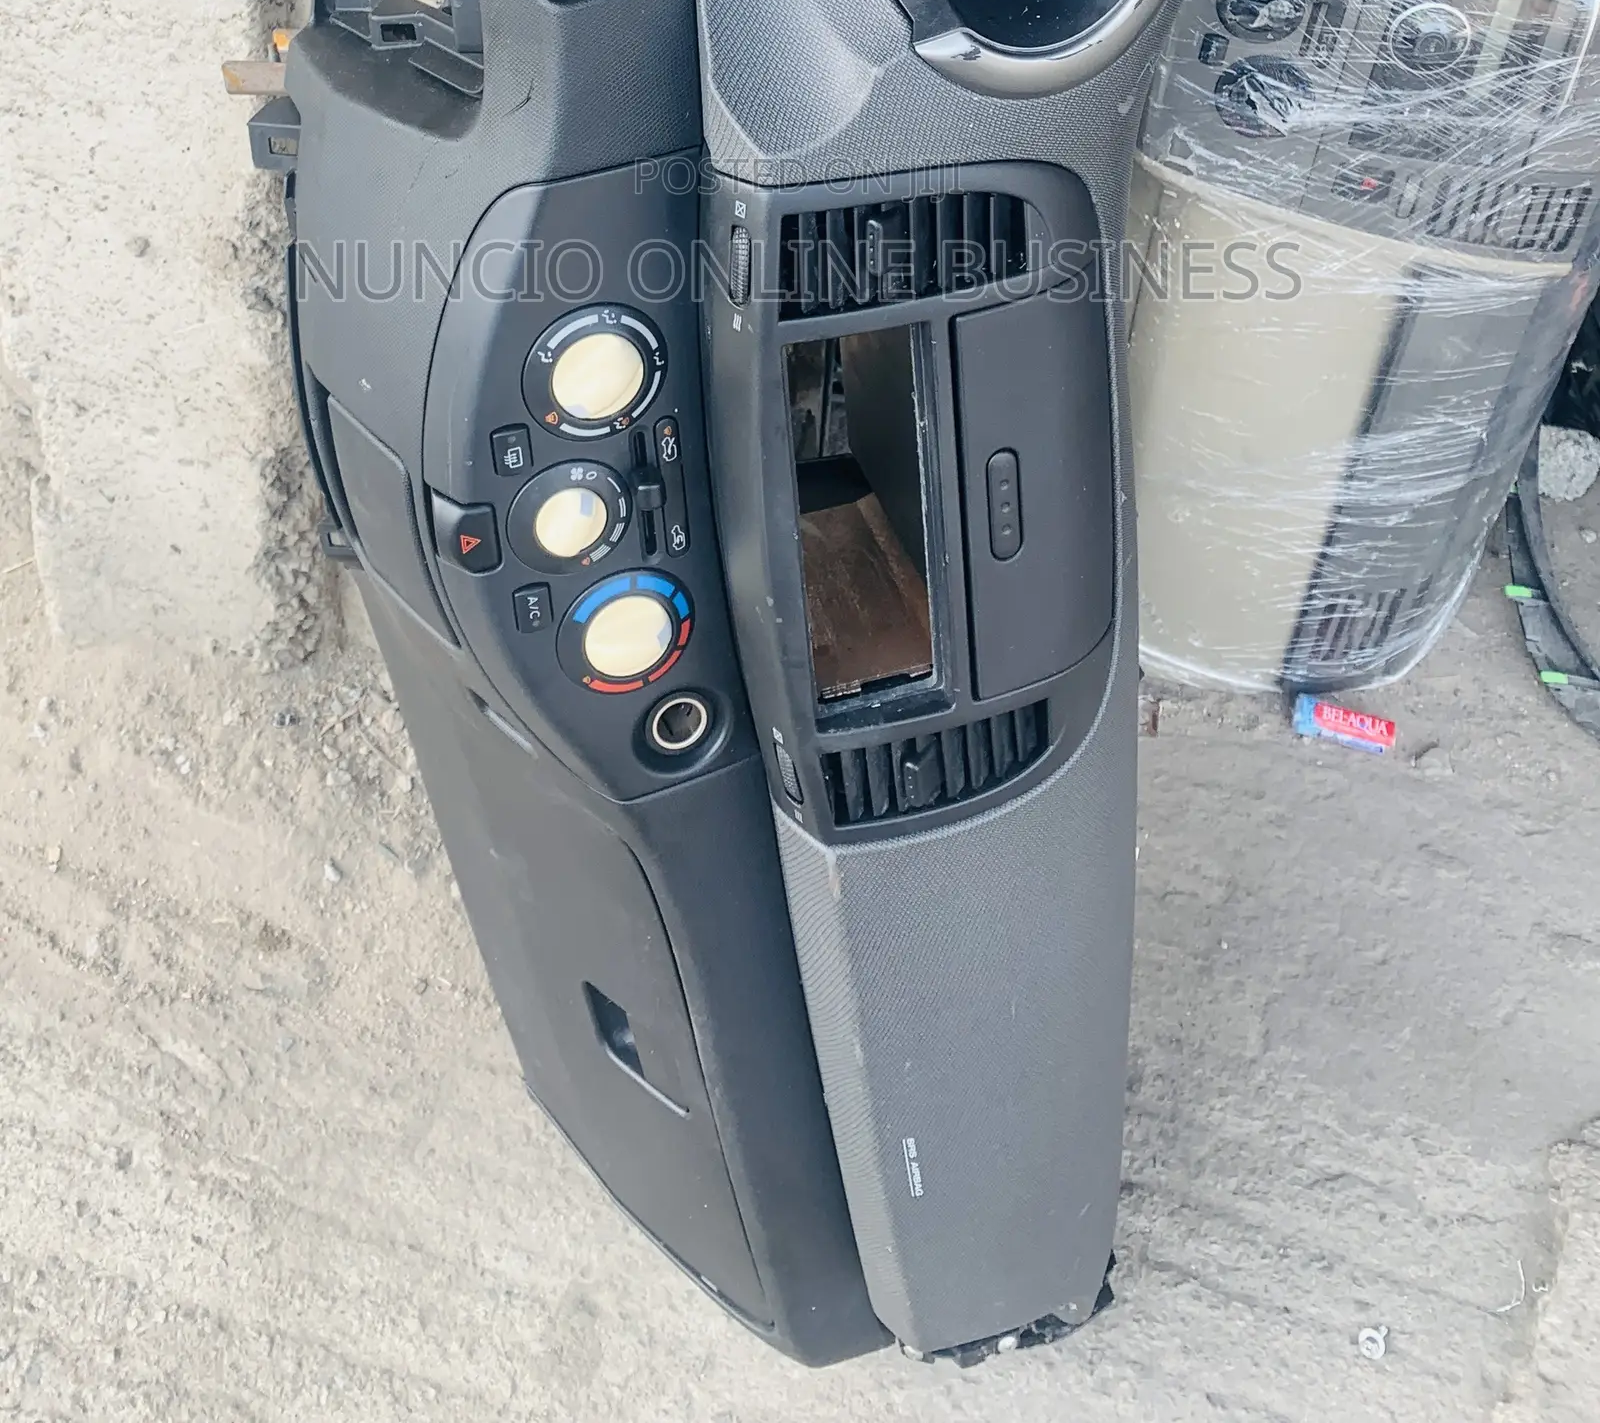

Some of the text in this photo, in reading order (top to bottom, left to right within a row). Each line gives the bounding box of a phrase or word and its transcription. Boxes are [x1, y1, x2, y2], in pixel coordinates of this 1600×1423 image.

[585, 471, 597, 480] 0
[527, 596, 541, 620] A/C
[907, 1138, 924, 1196] SRS AIRBAG
